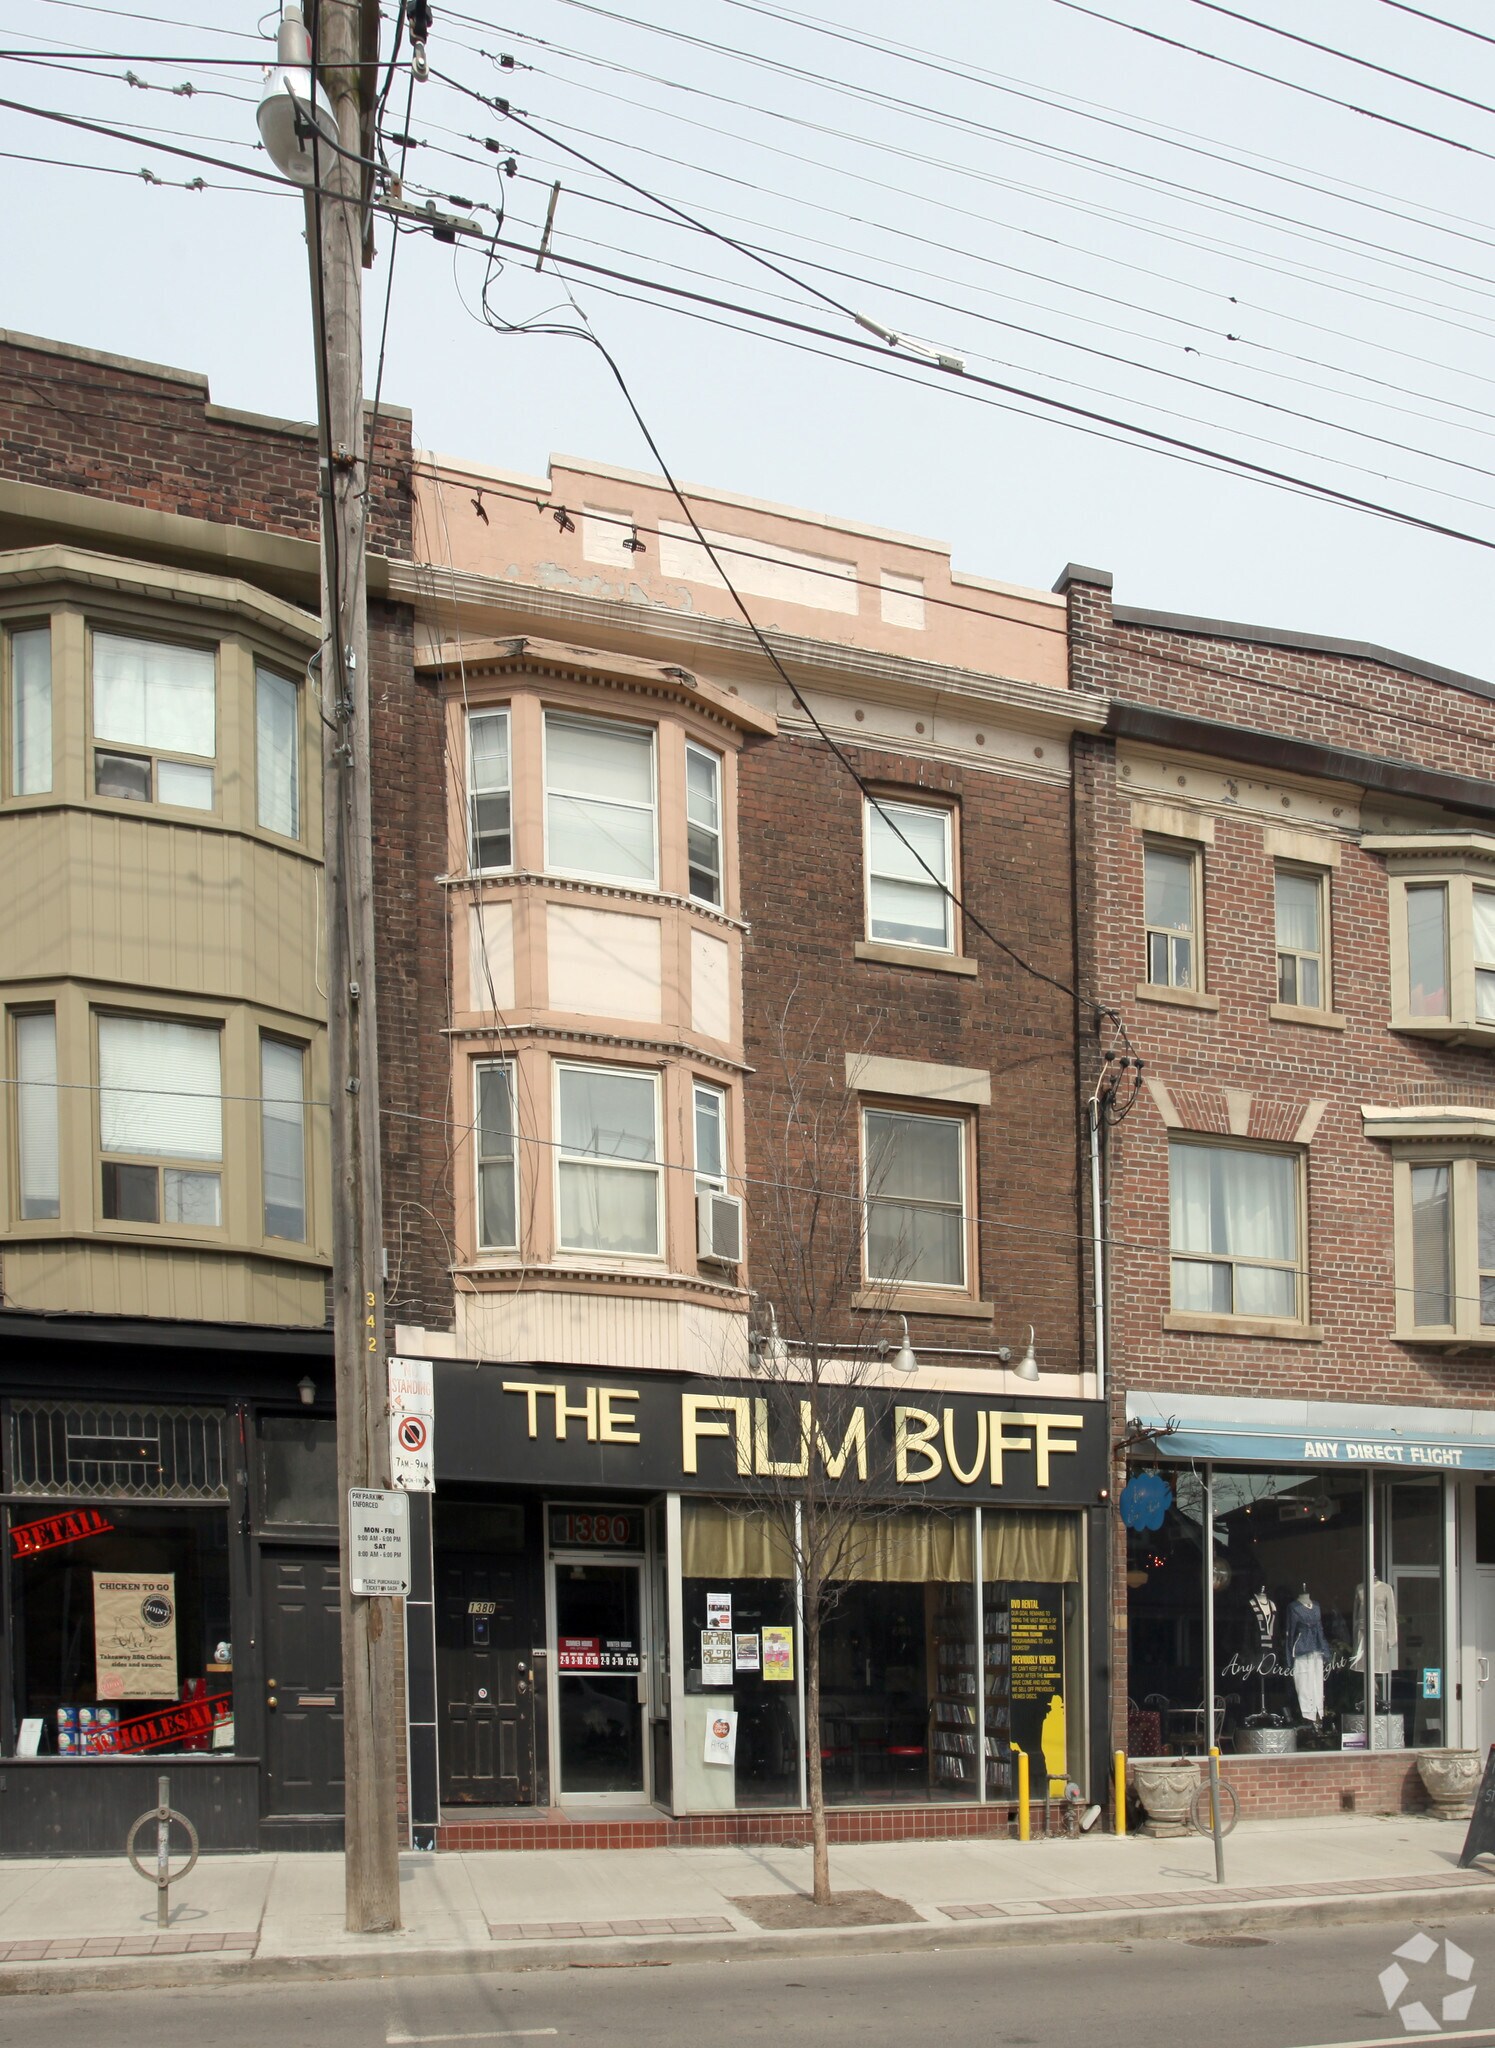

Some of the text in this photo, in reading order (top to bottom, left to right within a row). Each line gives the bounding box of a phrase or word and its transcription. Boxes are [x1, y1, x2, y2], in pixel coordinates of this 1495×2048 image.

[403, 1362, 418, 1377] NO
[391, 1380, 432, 1396] STANDING
[502, 1381, 1084, 1488] THE FILM BUFF
[1304, 1441, 1463, 1465] ANY DIRECT FLIGHT
[395, 1457, 409, 1469] 7AM
[415, 1458, 429, 1469] 9AM
[352, 1492, 384, 1501] PAY PARKING
[352, 1501, 379, 1509] ENFORCED
[12, 1509, 108, 1552] RETAIL
[566, 1513, 629, 1544] 1380
[99, 1582, 170, 1591] CHICKEN TO GO
[146, 1604, 169, 1617] JOINT
[470, 1603, 495, 1613] 1380
[1021, 1599, 1039, 1609] RENTAL
[1011, 1655, 1056, 1664] PREVIOUSLY VIEWED
[1221, 1651, 1348, 1681] Any Direc ight
[91, 1700, 233, 1753] WHOLESALE
